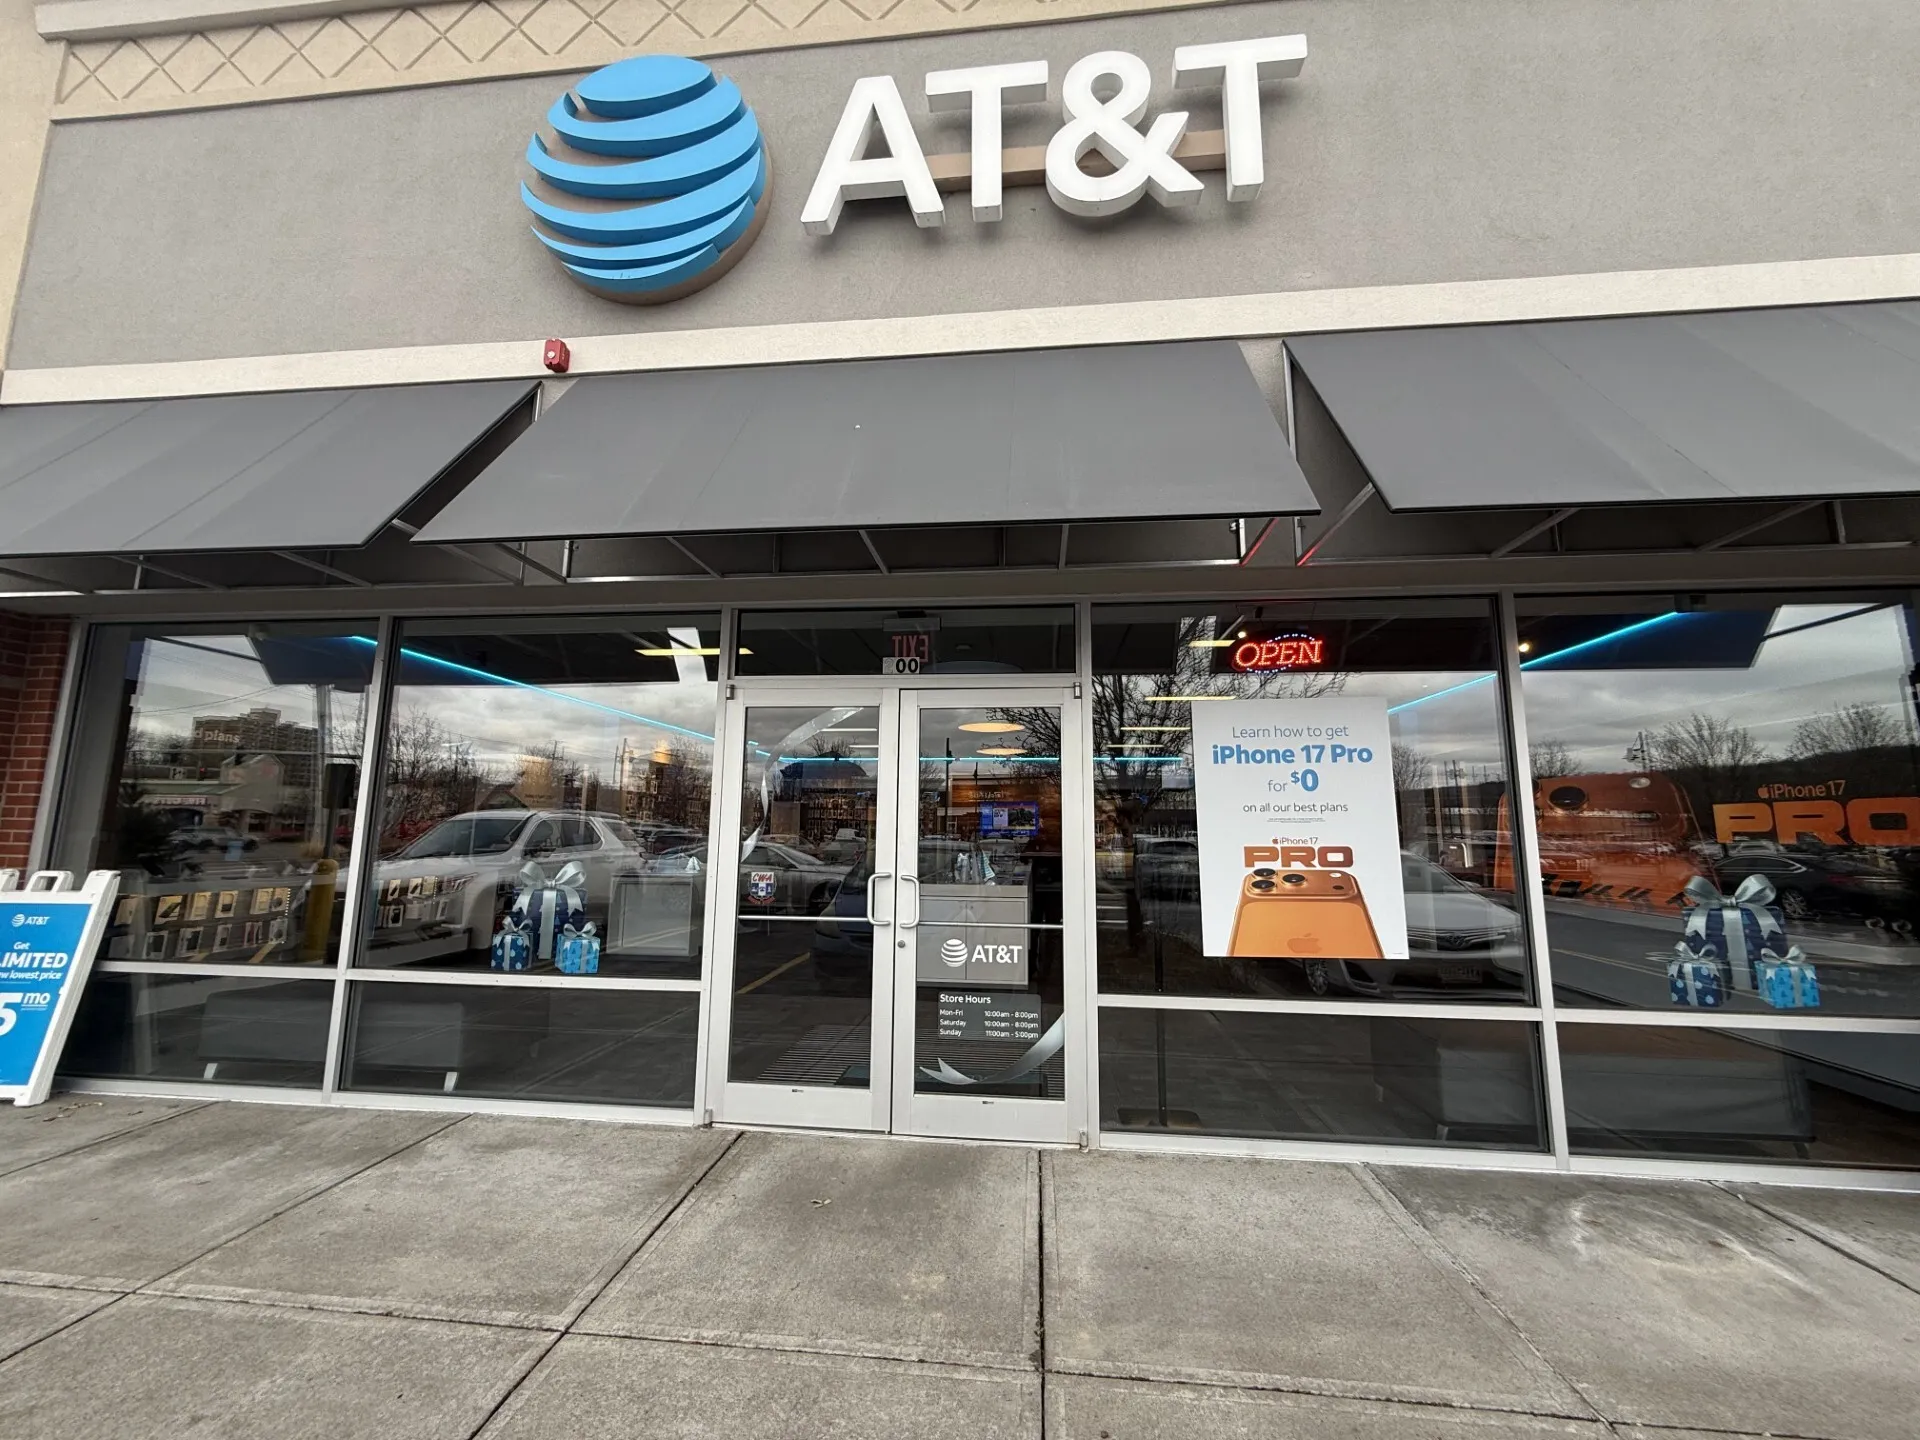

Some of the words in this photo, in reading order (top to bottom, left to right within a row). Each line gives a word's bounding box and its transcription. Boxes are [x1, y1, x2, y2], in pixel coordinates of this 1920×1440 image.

[801, 34, 1308, 234] AT&T
[1235, 640, 1323, 667] OPEN
[886, 658, 919, 673] 00
[203, 730, 240, 743] plans
[1232, 726, 1271, 739] Learn
[1273, 725, 1304, 738] how
[1306, 726, 1322, 737] to
[1325, 725, 1350, 740] get
[1212, 744, 1295, 764] iPhone
[1300, 744, 1326, 763] 17
[1330, 744, 1373, 763] Pro
[1267, 780, 1288, 792] for
[1290, 768, 1319, 792] $0
[1769, 783, 1826, 799] iPhone
[1827, 779, 1847, 796] 17
[1243, 804, 1257, 813] on
[1259, 802, 1271, 813] all
[1272, 804, 1291, 813] our
[1294, 802, 1317, 812] best
[1320, 801, 1349, 815] plans
[1712, 796, 1920, 846] PRO
[1279, 837, 1309, 845] iPhone
[1309, 837, 1318, 845] 17
[1244, 846, 1354, 868] PRO
[753, 873, 773, 883] CWA
[24, 916, 50, 926] AT&T
[13, 941, 31, 950] Get
[0, 952, 68, 968] IMITED
[971, 945, 1023, 964] AT&T
[10, 970, 40, 979] lowest
[39, 971, 62, 981] price
[23, 992, 51, 1005] mo
[940, 994, 964, 1003] Store
[965, 995, 991, 1004] Hours
[984, 1010, 1010, 1018] 10:00am
[940, 1019, 966, 1027] Saturday
[984, 1020, 1010, 1028] 10:00am
[940, 1029, 962, 1037] Sunday
